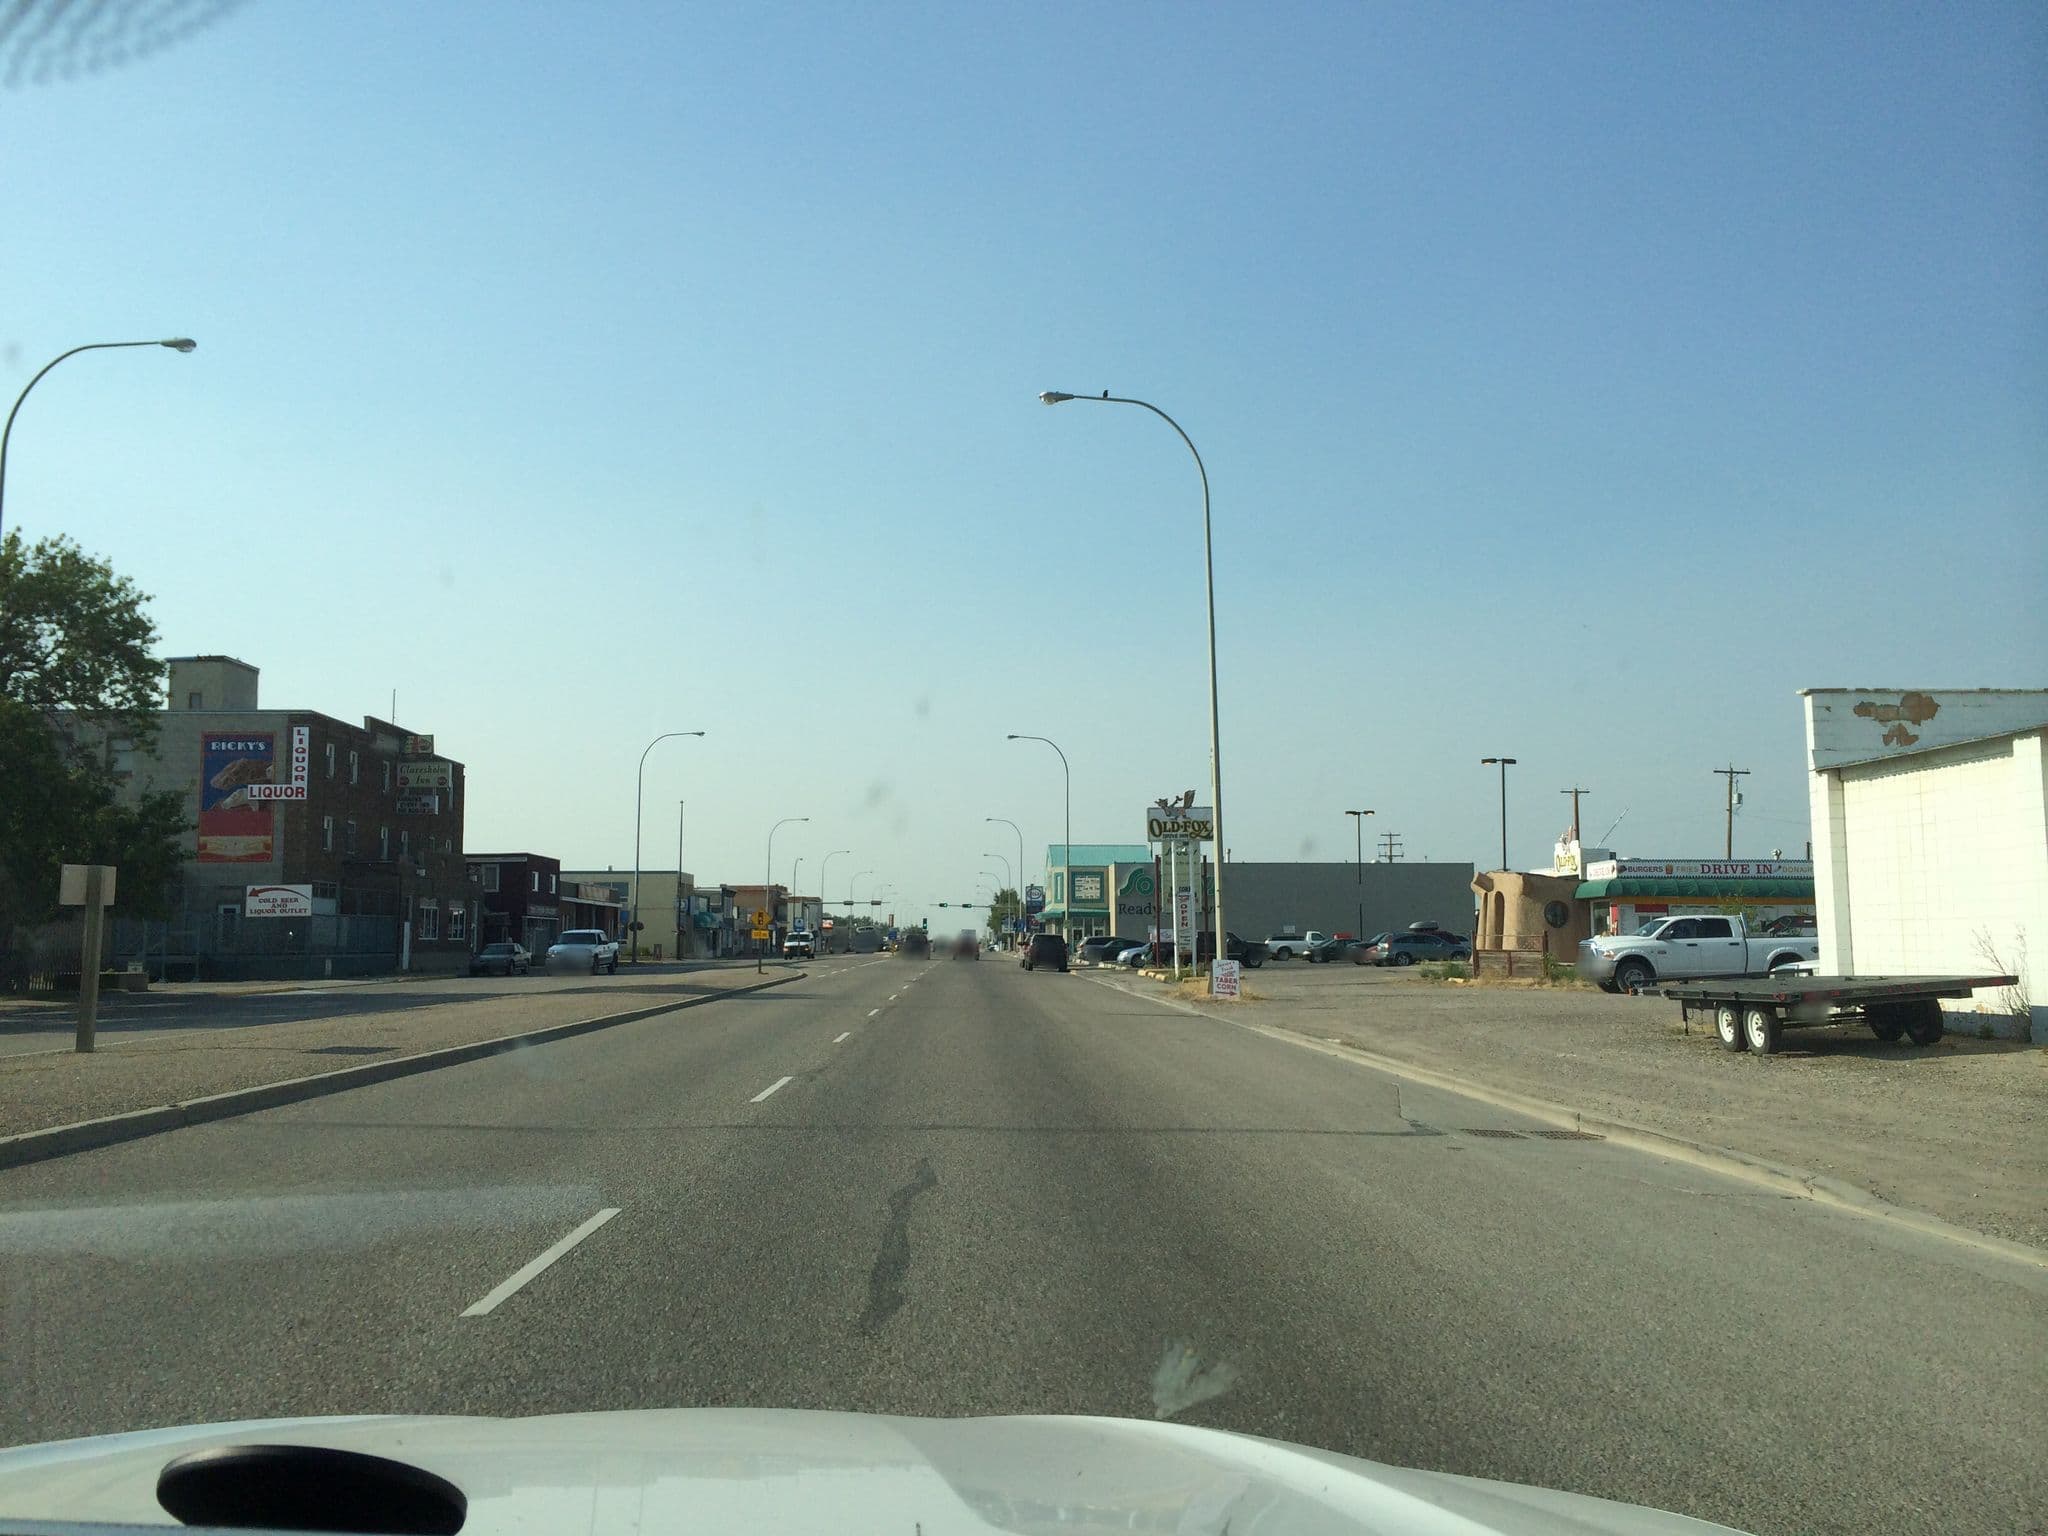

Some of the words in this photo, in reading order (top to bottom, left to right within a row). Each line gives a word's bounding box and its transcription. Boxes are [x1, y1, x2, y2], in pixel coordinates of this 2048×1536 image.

[211, 741, 266, 751] RICKY'S
[294, 729, 307, 782] LIQUOR
[249, 786, 306, 798] LIQUOR
[1628, 865, 1664, 873] BURGERS
[1701, 864, 1751, 875] DRIVE
[1756, 864, 1773, 875] IN
[1180, 904, 1189, 927] OPEN
[1215, 976, 1239, 985] TABER
